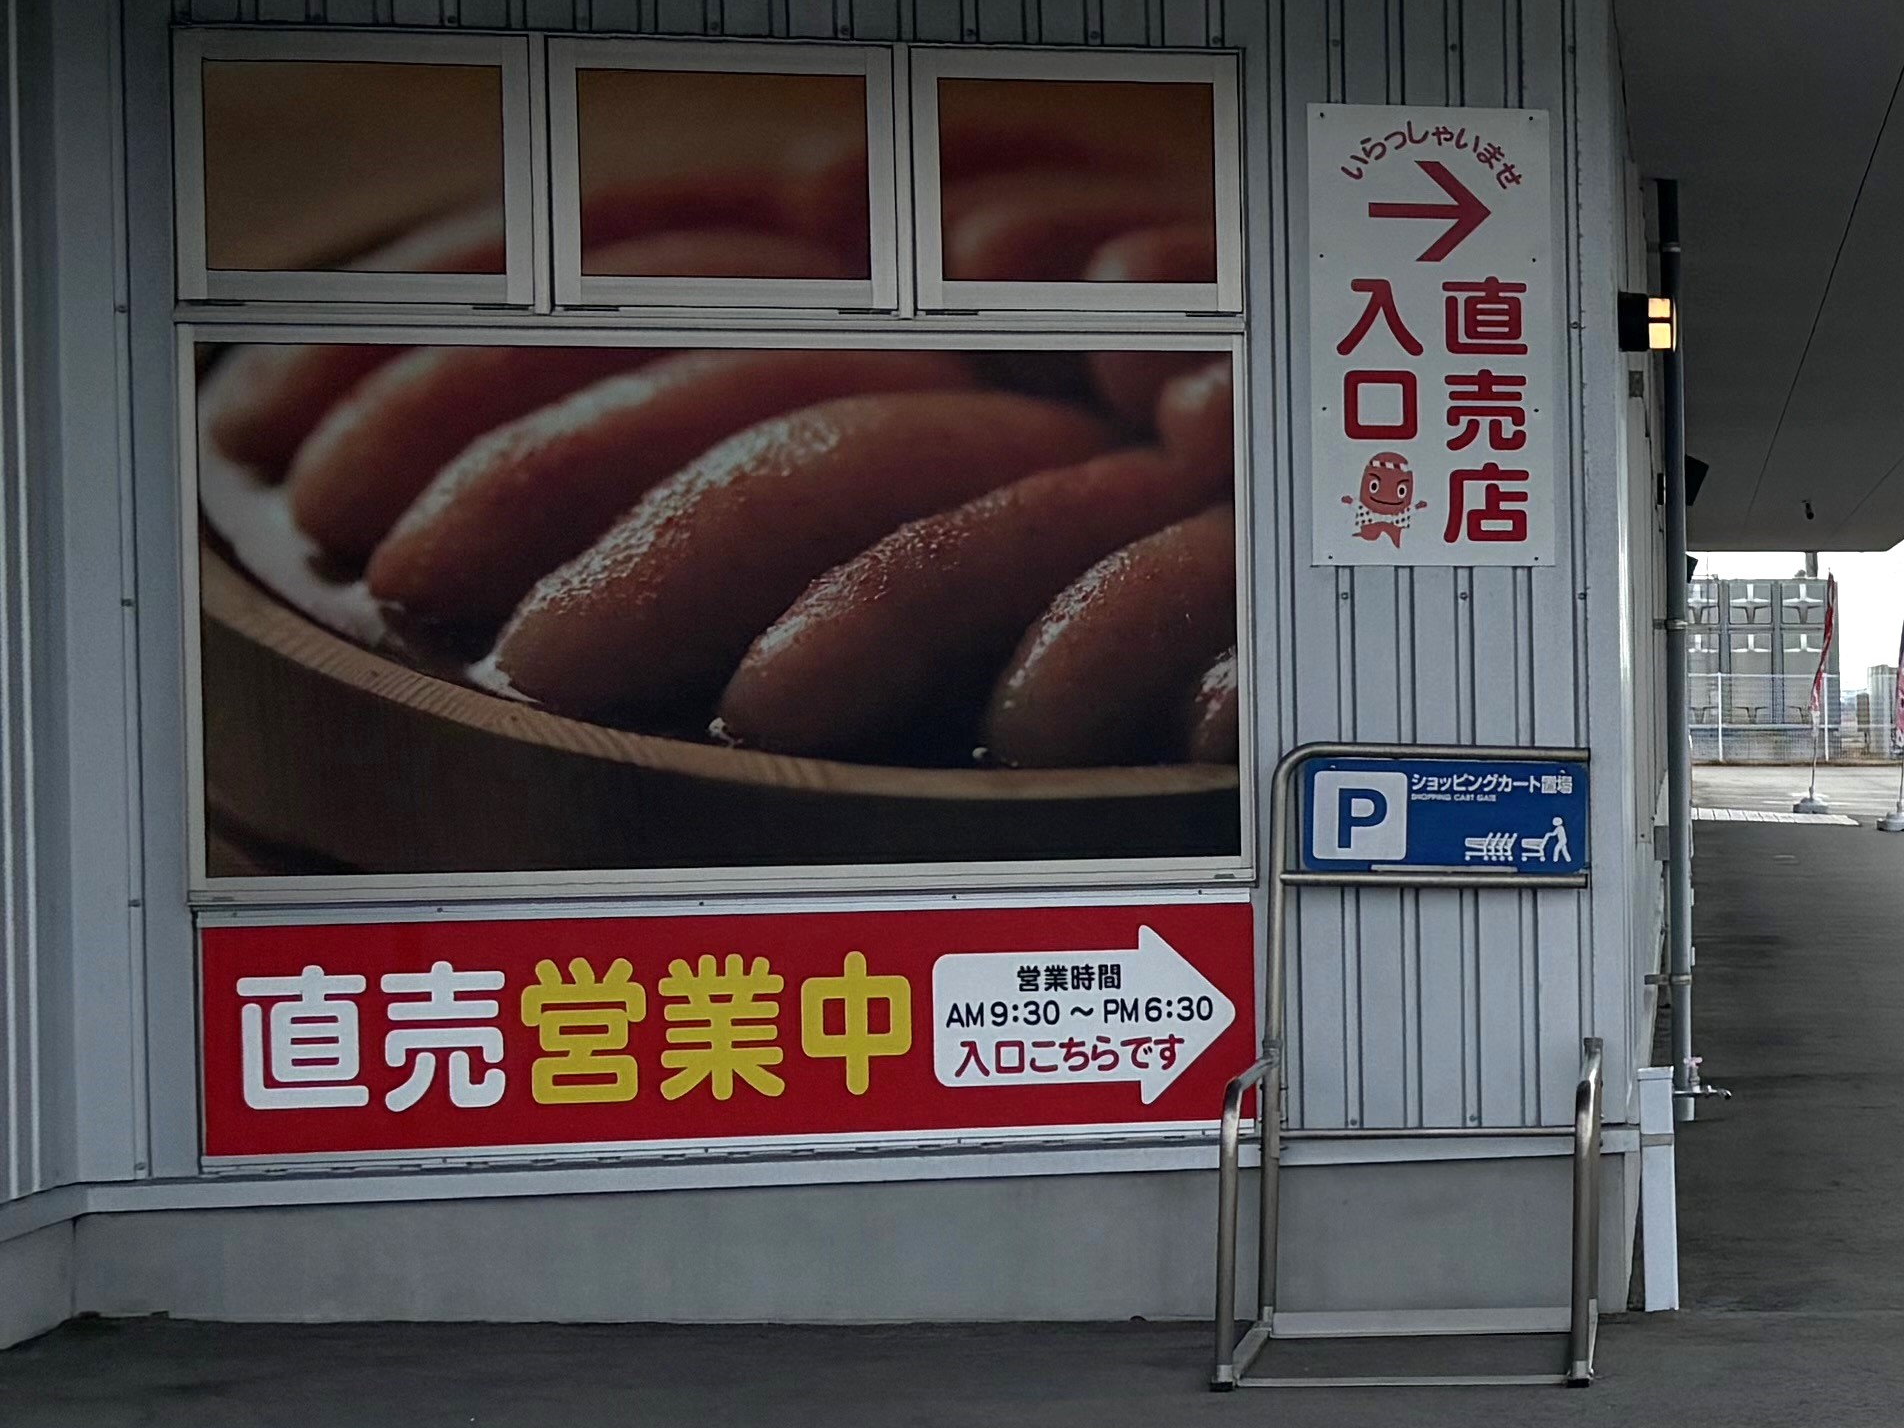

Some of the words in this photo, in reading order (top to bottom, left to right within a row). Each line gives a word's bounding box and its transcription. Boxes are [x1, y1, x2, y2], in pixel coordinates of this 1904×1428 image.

[1340, 120, 1523, 190] いらっしゃいませ
[1336, 277, 1424, 441] 入口
[1441, 275, 1530, 544] 直売店
[1410, 773, 1573, 795] ショッピングカート置場
[1336, 787, 1388, 850] P
[1016, 963, 1122, 993] 営業時間
[236, 950, 914, 1112] 直売営業中
[954, 1033, 1186, 1078] 入口こちらです
